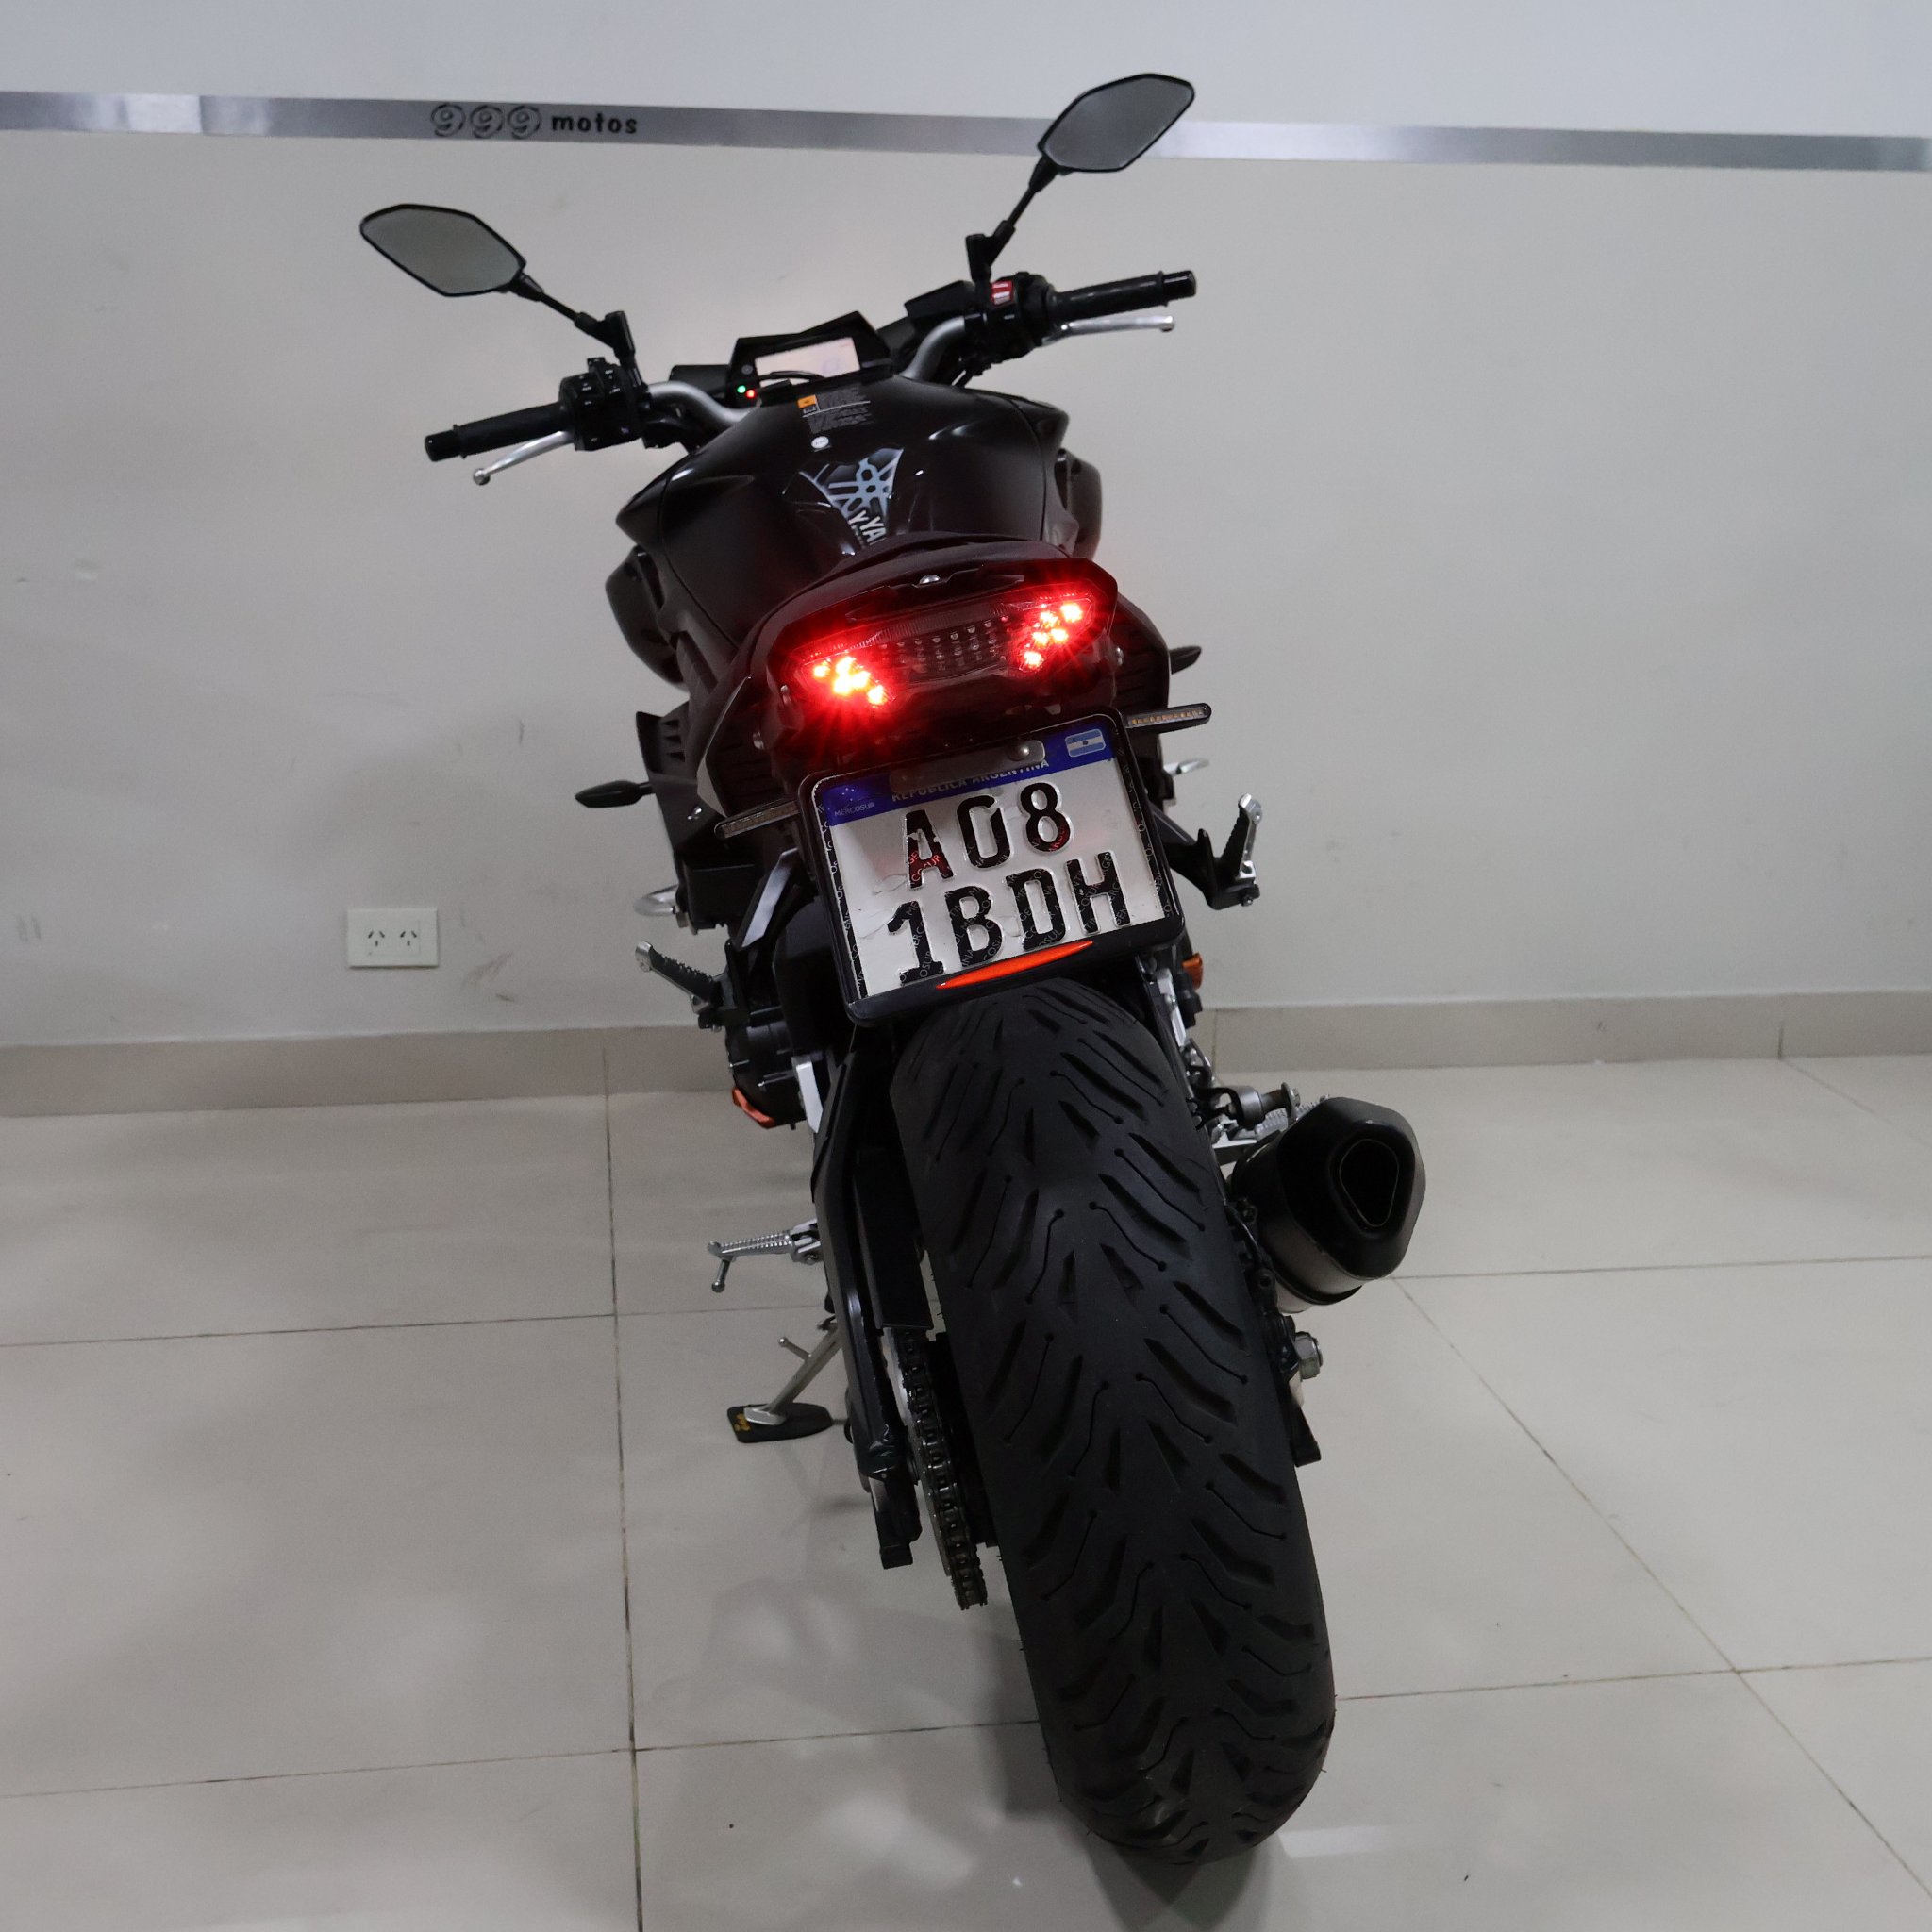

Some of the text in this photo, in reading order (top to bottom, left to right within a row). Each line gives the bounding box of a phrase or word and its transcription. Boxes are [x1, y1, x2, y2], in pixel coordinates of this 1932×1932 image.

[430, 103, 638, 139] 999 motos
[905, 782, 1072, 889] A08
[887, 851, 1132, 983] 1BDH
